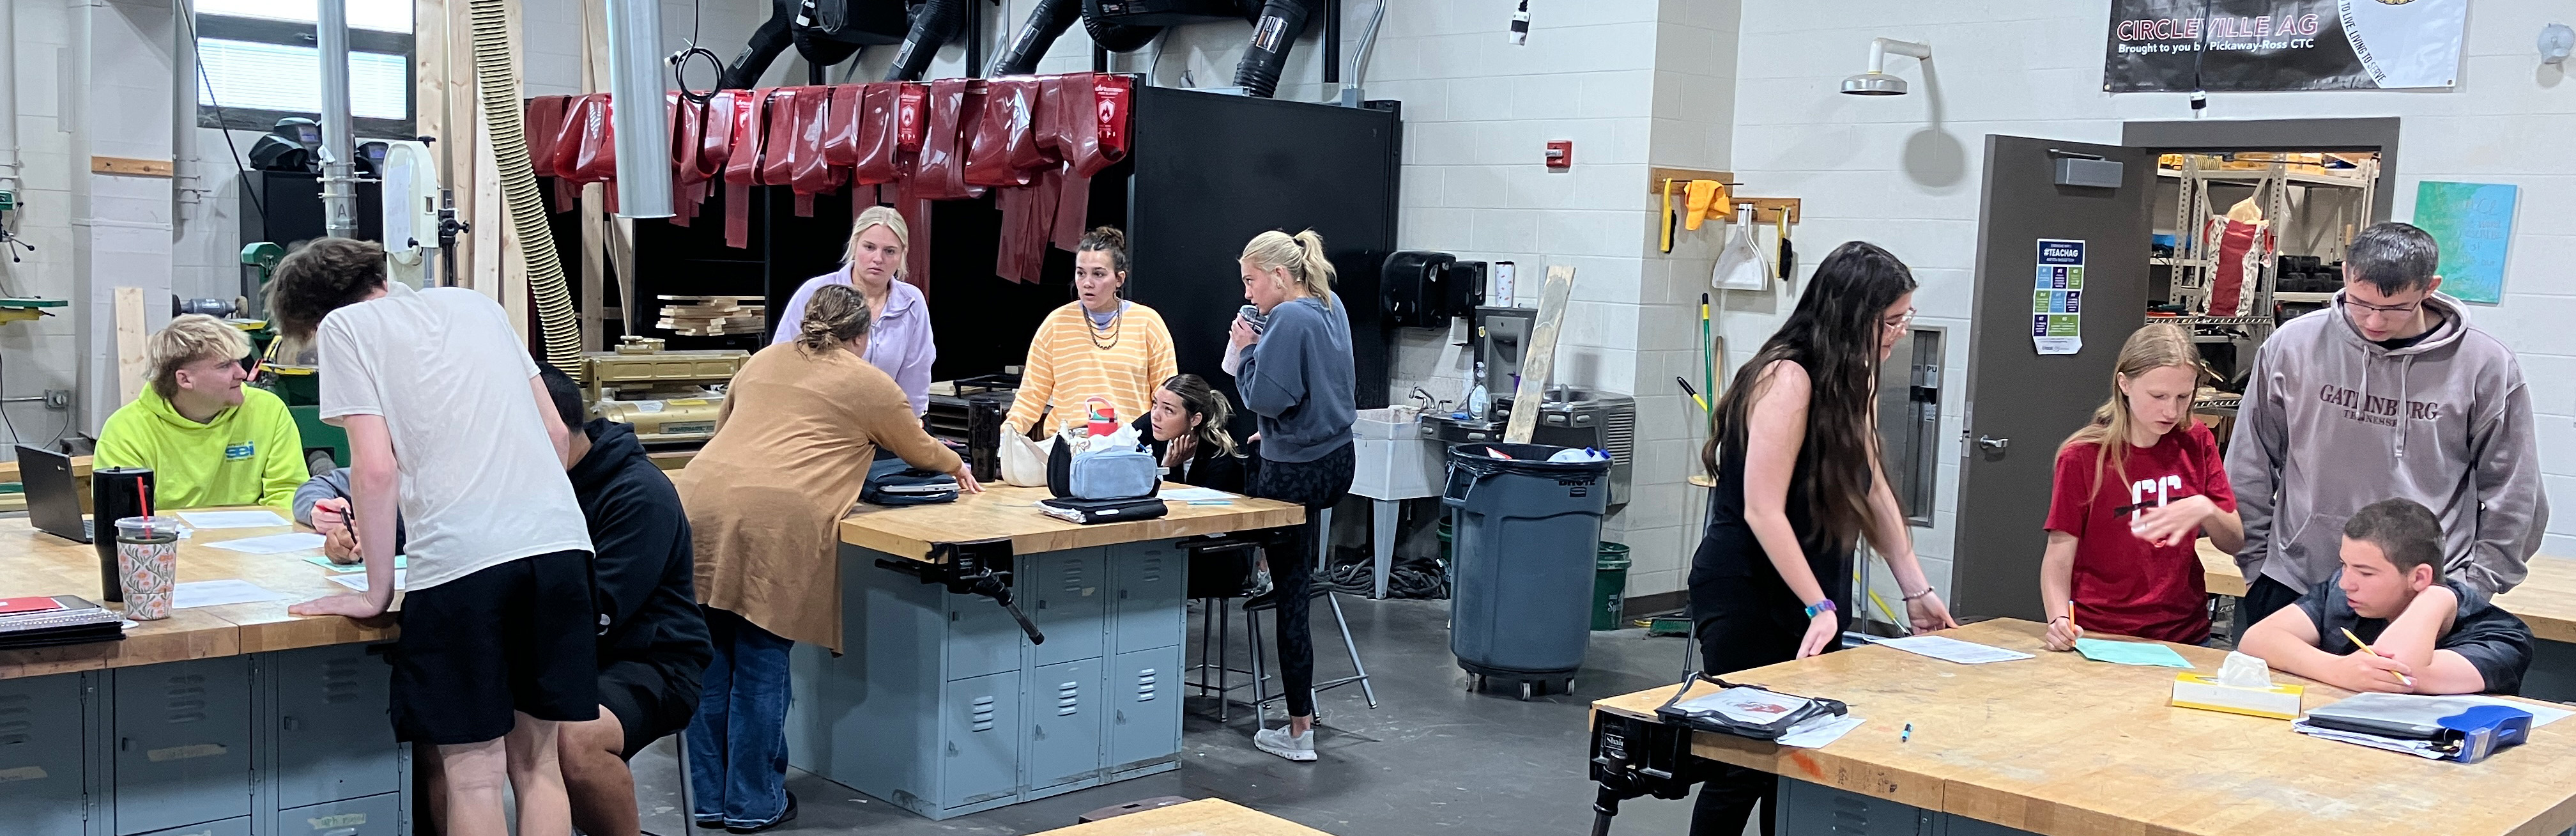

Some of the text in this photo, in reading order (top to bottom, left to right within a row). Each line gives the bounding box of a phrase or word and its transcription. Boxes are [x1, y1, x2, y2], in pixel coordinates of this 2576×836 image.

[2117, 13, 2319, 41] CIRCLEVILLE AG
[2118, 43, 2158, 55] Brought
[2159, 43, 2169, 52] to
[2172, 45, 2191, 54] you
[2209, 40, 2287, 52] Pickaway-Ross
[2290, 38, 2315, 49] CTC
[2349, 31, 2367, 54] LIVING
[2362, 52, 2373, 63] TO
[337, 204, 347, 218] A
[2043, 248, 2079, 258] #TEACHAG
